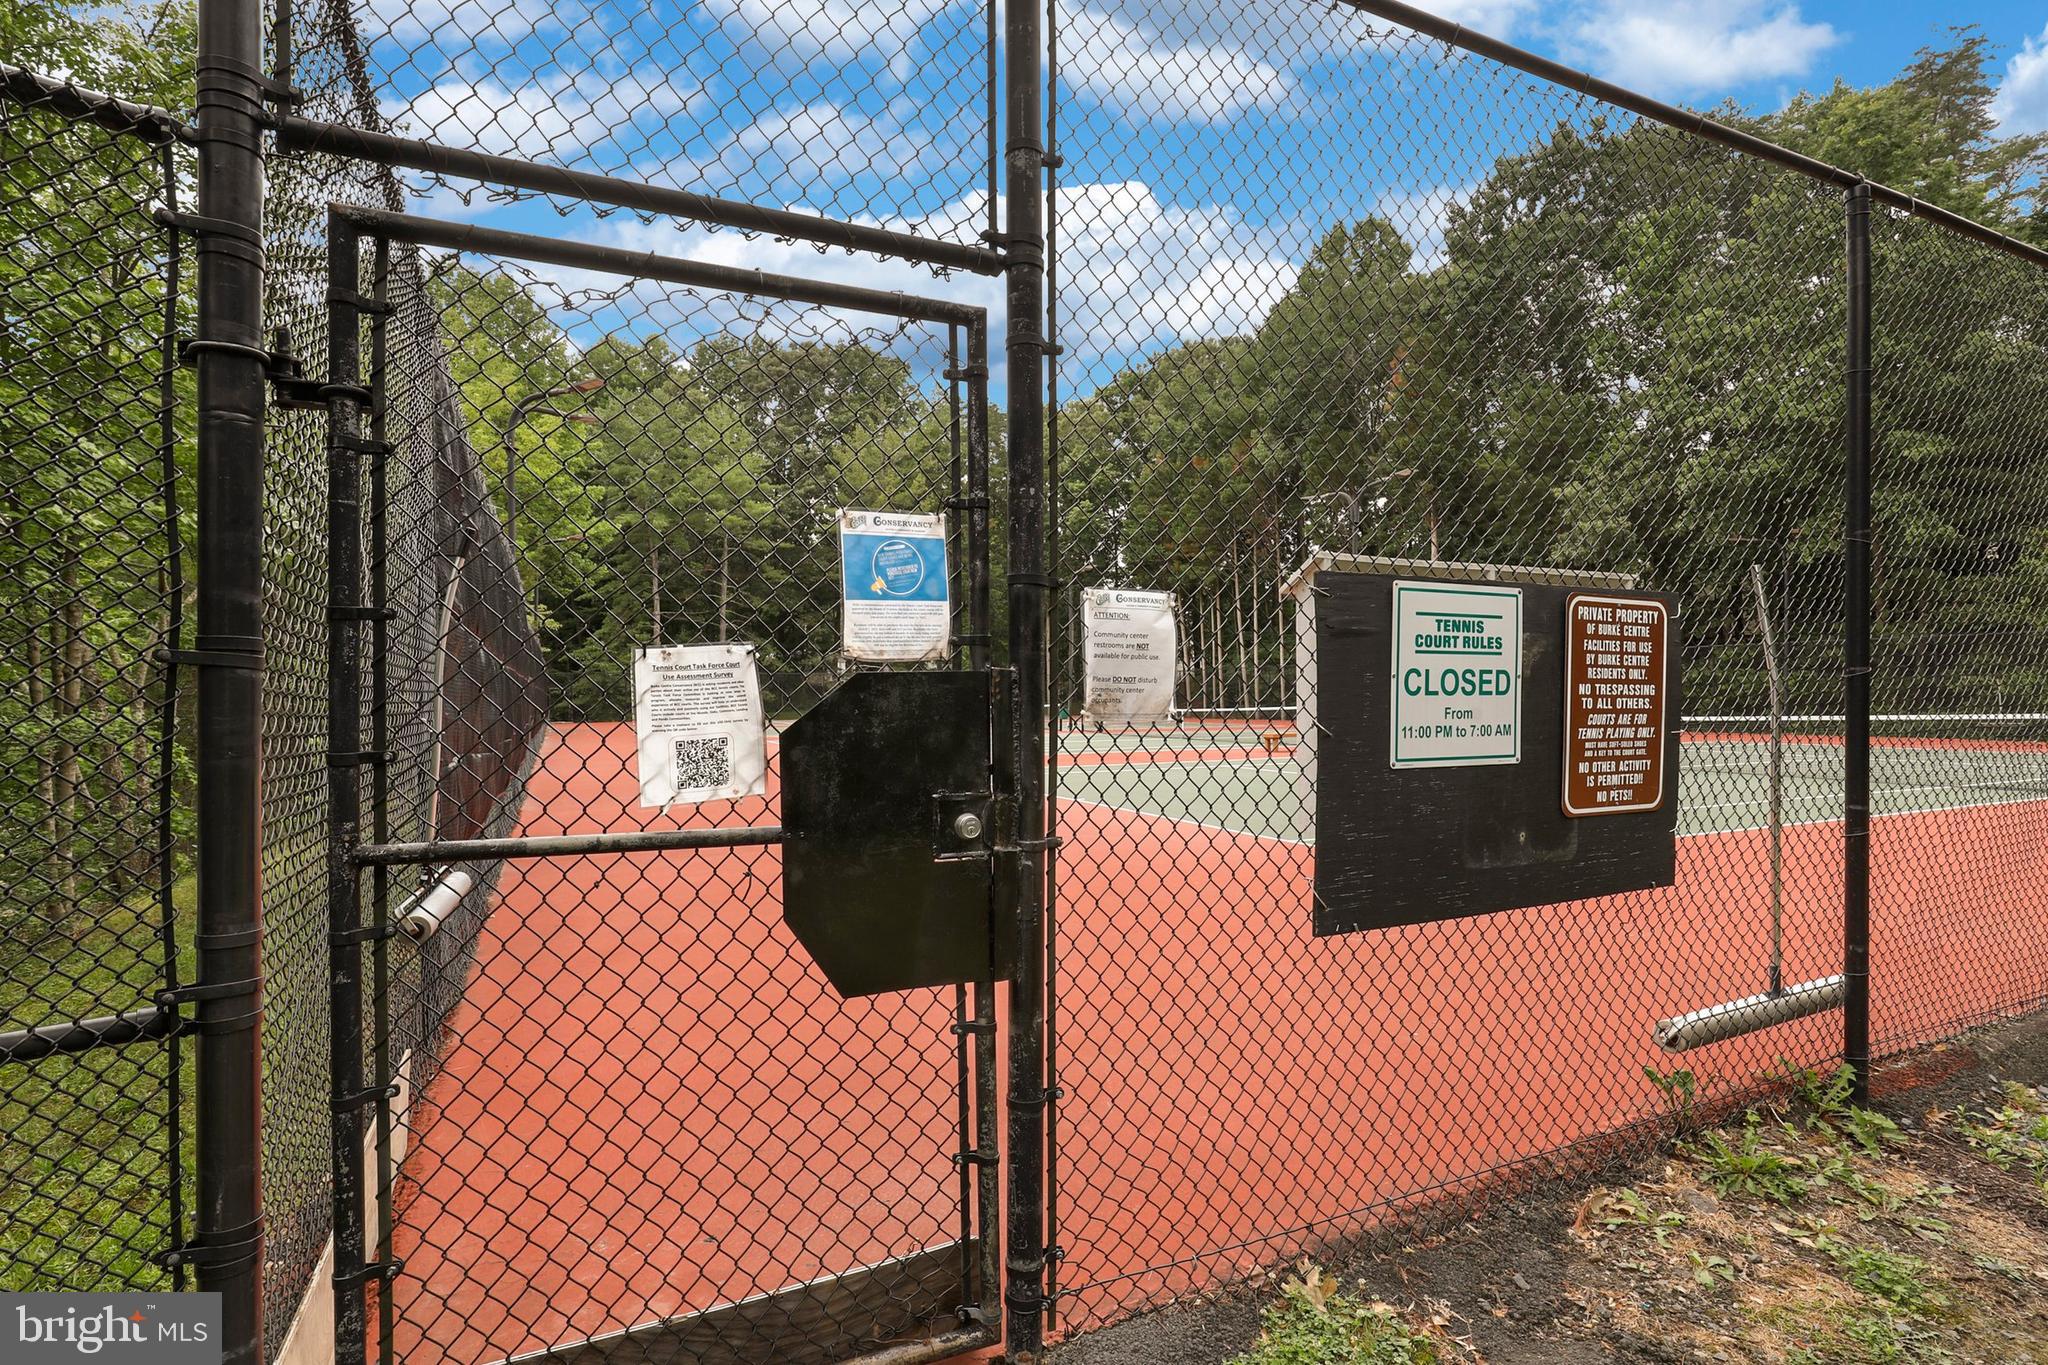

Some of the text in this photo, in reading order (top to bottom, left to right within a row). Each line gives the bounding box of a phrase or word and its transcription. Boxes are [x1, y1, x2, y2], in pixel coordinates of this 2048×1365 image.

[1578, 606, 1658, 624] PRIVATE PROPERTY
[1435, 619, 1484, 633] TENNIS
[1587, 623, 1650, 637] OF BURKE CENTRE
[1093, 630, 1149, 640] Community center
[1415, 634, 1502, 649] COURT RULES
[1093, 641, 1124, 649] restrooms
[1136, 643, 1150, 651] NOT
[1584, 639, 1652, 653] FACILITIES FOR USE
[1093, 652, 1121, 660] available
[1121, 652, 1131, 660] for
[1131, 653, 1148, 662] public
[1586, 653, 1649, 666] BY BURKE CENTRE
[652, 661, 740, 672] Tennis Court Task Force Court
[676, 672, 712, 680] Assessment
[713, 671, 734, 679] Survey
[1092, 675, 1112, 684] Please
[1112, 676, 1123, 684] DO
[1123, 676, 1137, 684] NOT
[1587, 667, 1648, 680] RESIDENTS ONLY.
[1404, 668, 1511, 697] CLOSED
[1091, 687, 1125, 695] community
[1578, 683, 1656, 696] NO TRESPASSING
[1581, 698, 1653, 709] TO ALL OTHERS.
[1444, 707, 1473, 720] From
[1587, 714, 1648, 725] COURTS ARE FOR
[1401, 724, 1512, 739] 11:00 PM to 7:00 AM
[1578, 727, 1656, 740] TENNIS PLAYING ONLY.
[1578, 760, 1652, 774] NO OTHER ACTIVITY
[1587, 773, 1644, 788] IS PERMITTED!!
[1596, 789, 1633, 803] NO PETS!!
